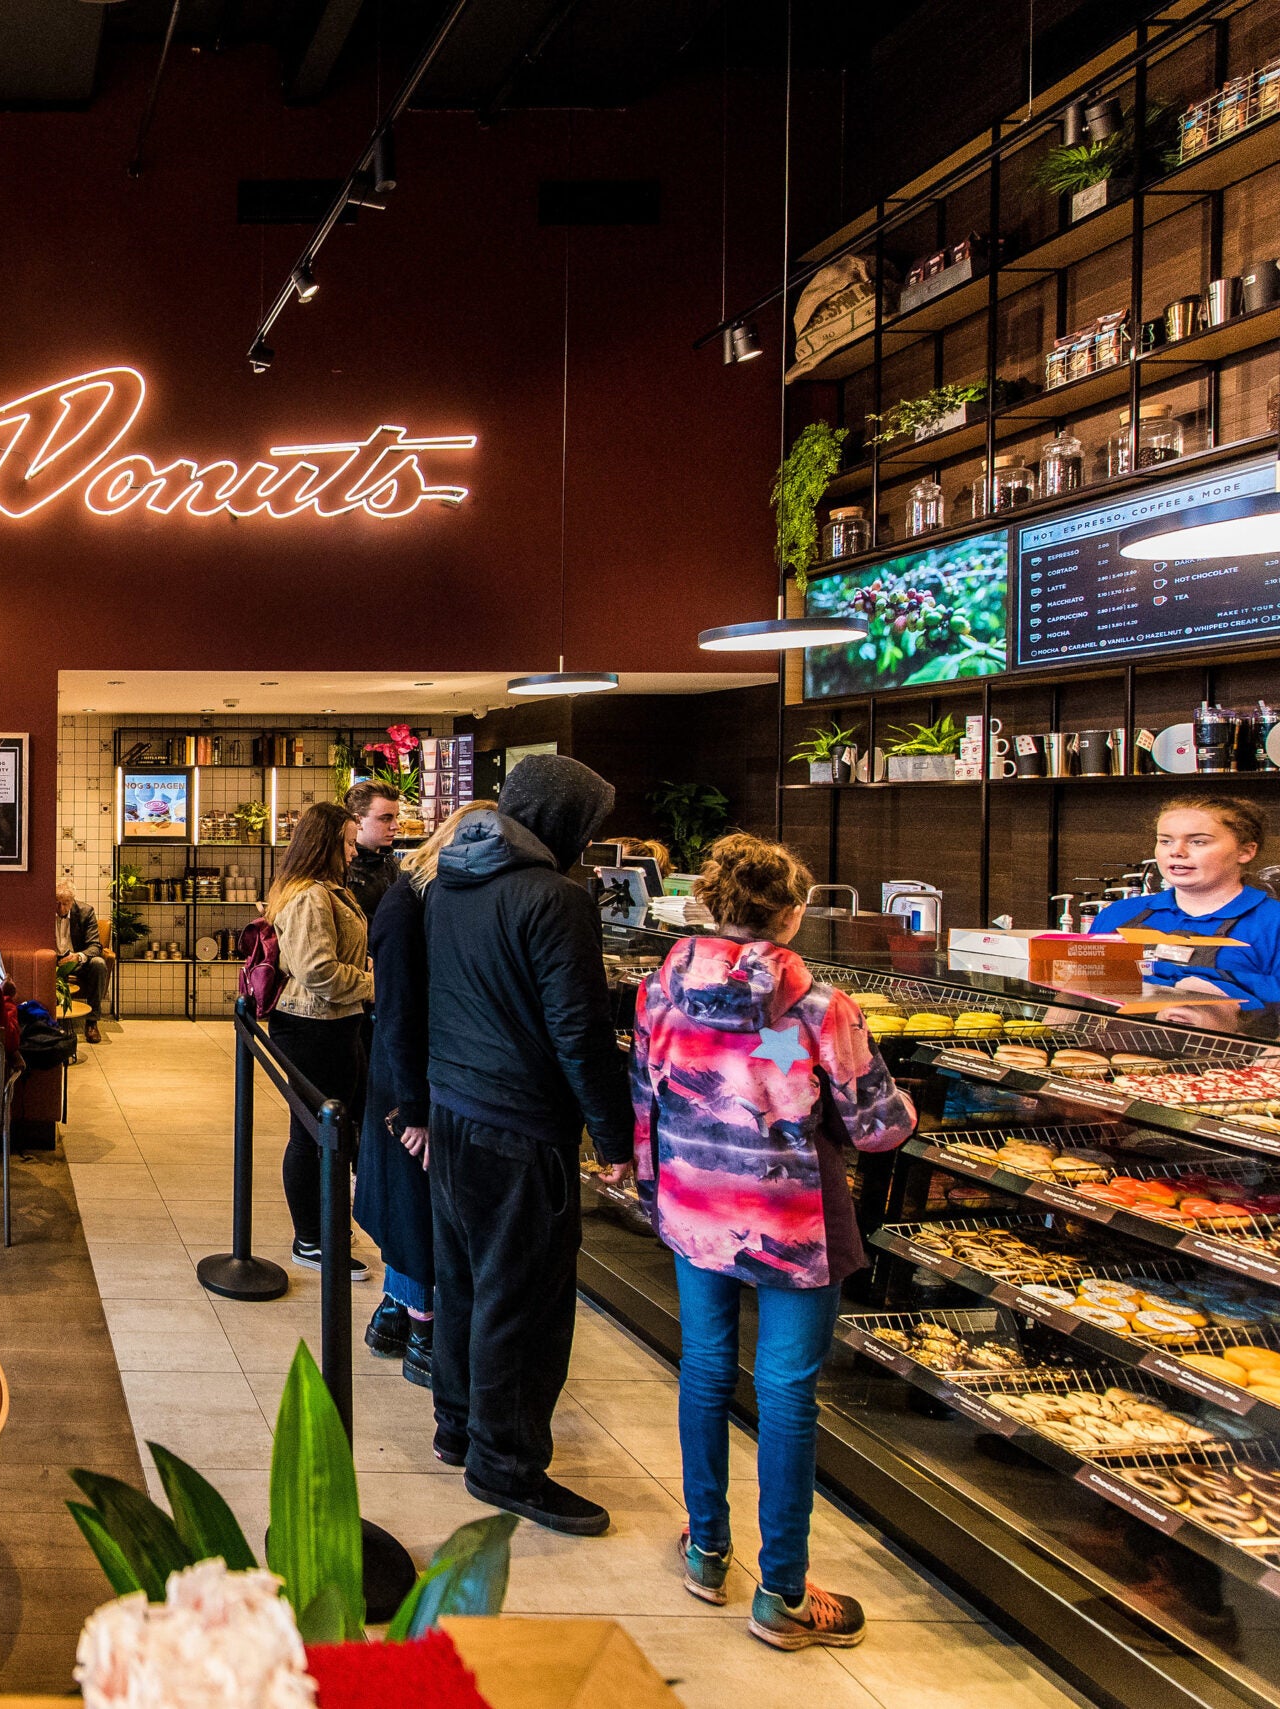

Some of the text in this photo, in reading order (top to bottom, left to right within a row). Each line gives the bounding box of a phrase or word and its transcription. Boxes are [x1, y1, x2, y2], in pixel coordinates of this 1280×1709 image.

[1033, 530, 1054, 542] HOT
[1063, 514, 1125, 534] ESPRESSO,
[1131, 498, 1181, 516] COFFEE
[1202, 482, 1240, 498] MORE
[1047, 549, 1080, 562] ESPRESSO
[1047, 565, 1078, 577] CORTADO
[1174, 567, 1239, 584] HOT CHOCOLATE
[1047, 583, 1067, 593] LATTE
[1047, 595, 1085, 608] MACCHIATO
[1047, 611, 1088, 624] CAPPUCCINO
[1217, 610, 1239, 618] MAKE
[1252, 604, 1274, 612] YOUR
[1037, 647, 1059, 655] MOCHA
[1068, 641, 1098, 651] CARAMEL
[1107, 636, 1135, 645] VANILLA
[1145, 628, 1183, 640] HAZELNUT
[1194, 622, 1229, 632] WHIPPED
[1230, 618, 1259, 627] CREAM
[1046, 630, 1070, 639] MOCHA
[153, 782, 185, 790] DAGEN
[940, 1055, 968, 1066] Chocolate
[967, 1062, 1001, 1075] Cheesecake
[1083, 1091, 1125, 1105] Cheesecake
[939, 1152, 978, 1170] Unicorn Ring
[1043, 1189, 1077, 1204] Heartbeat
[1077, 1200, 1098, 1212] Heart
[1194, 1240, 1238, 1260] Chocolate
[1015, 1296, 1036, 1310] Dutch
[863, 1340, 880, 1353] Rocky
[1154, 1359, 1181, 1375] Apple
[1180, 1370, 1225, 1396] Cinnamon
[953, 1392, 982, 1411] Croissant
[981, 1407, 1002, 1423] Donut
[1089, 1473, 1132, 1502] Chocolate
